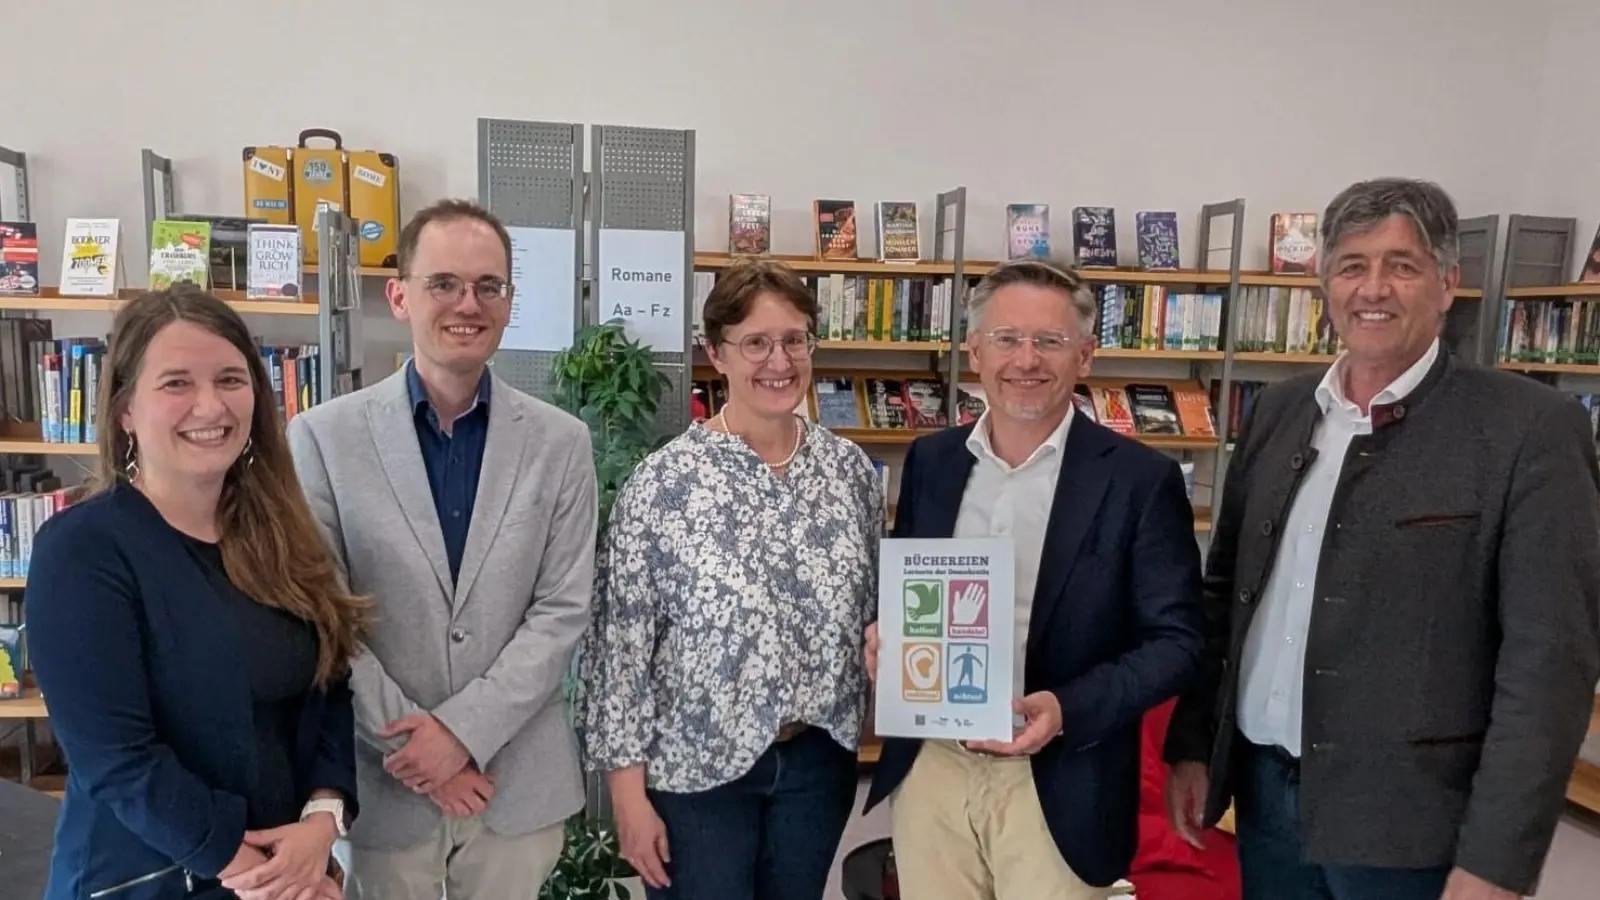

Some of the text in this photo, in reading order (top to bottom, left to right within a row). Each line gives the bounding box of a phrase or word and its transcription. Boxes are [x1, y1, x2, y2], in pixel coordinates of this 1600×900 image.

[71, 235, 111, 245] BOOMER
[256, 239, 294, 249] THINK
[256, 250, 293, 261] GROW
[259, 260, 290, 270] RICH
[611, 267, 672, 282] Romane
[612, 302, 633, 316] Aa
[651, 303, 672, 317] Fz
[903, 553, 989, 566] BÜCHEREIEN
